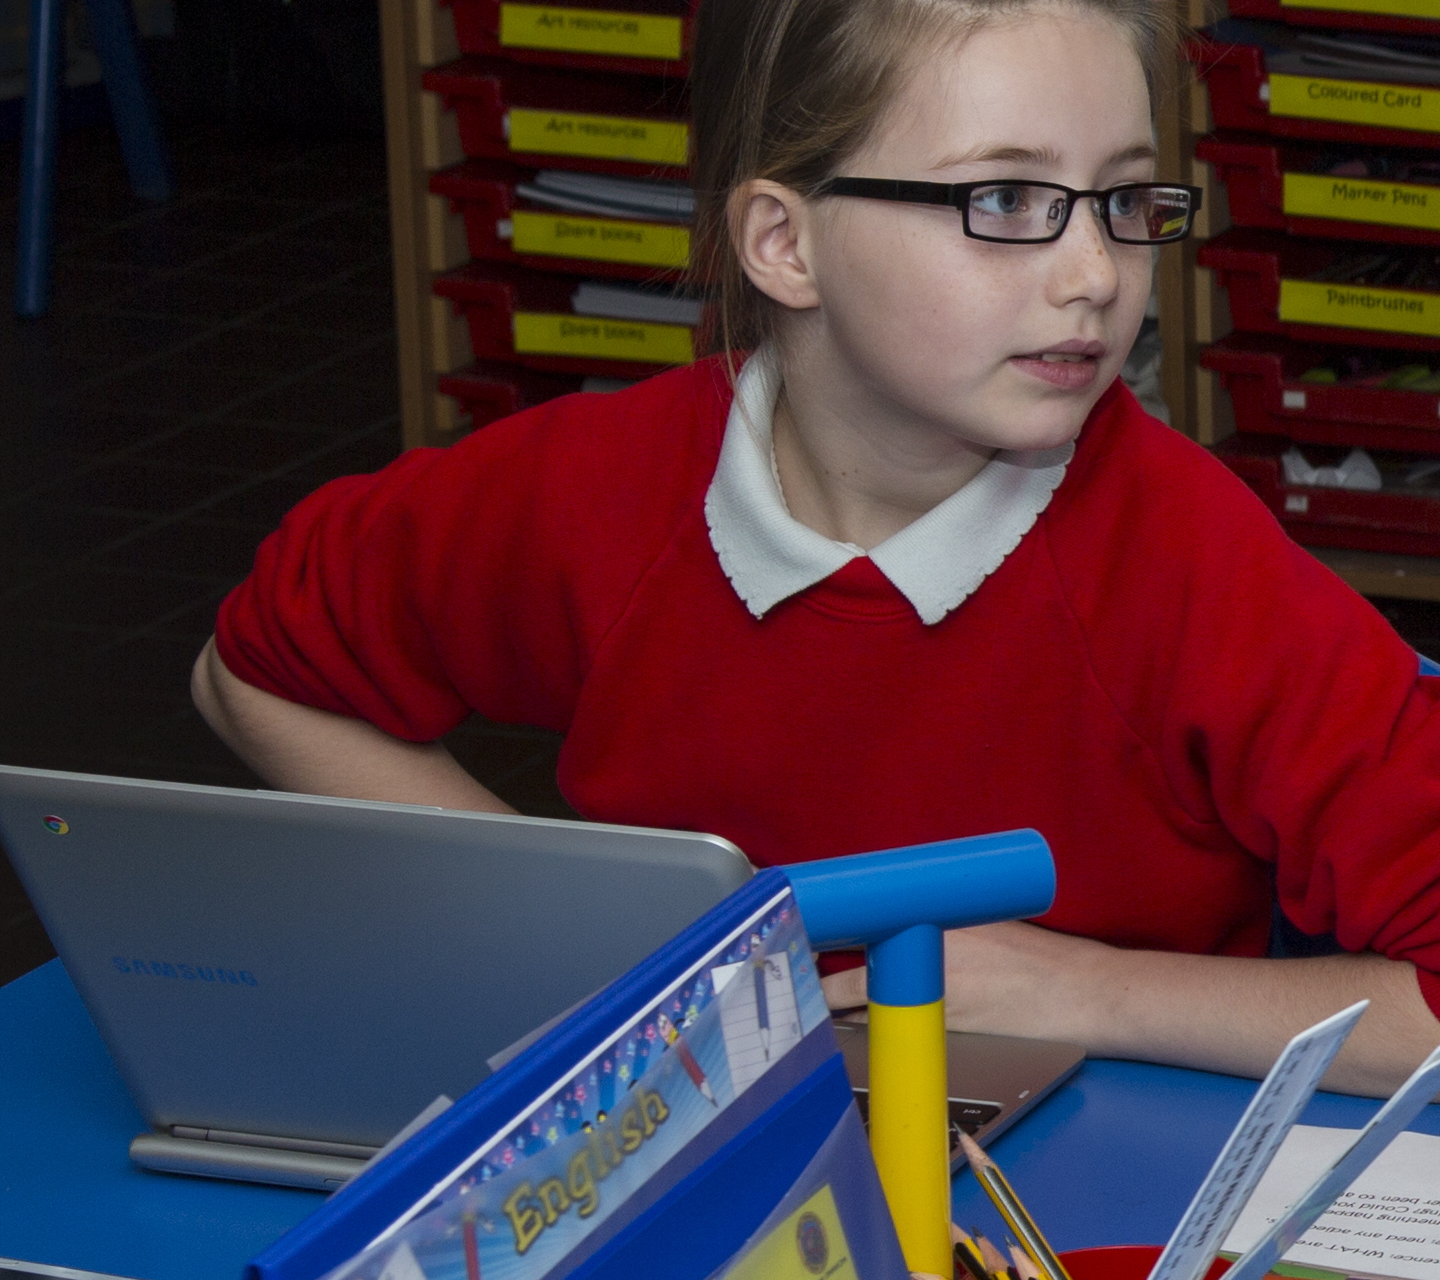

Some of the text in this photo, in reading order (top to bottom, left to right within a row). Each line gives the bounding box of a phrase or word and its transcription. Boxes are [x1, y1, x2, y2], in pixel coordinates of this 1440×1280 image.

[1307, 83, 1422, 108] Coloured Card
[1332, 183, 1427, 207] Marker Pens
[1327, 289, 1424, 314] Paintbrushes
[111, 955, 258, 987] SAMSUNG
[501, 1084, 671, 1256] English
[1382, 1195, 1419, 1204] been
[1325, 1244, 1384, 1259] WHAT
